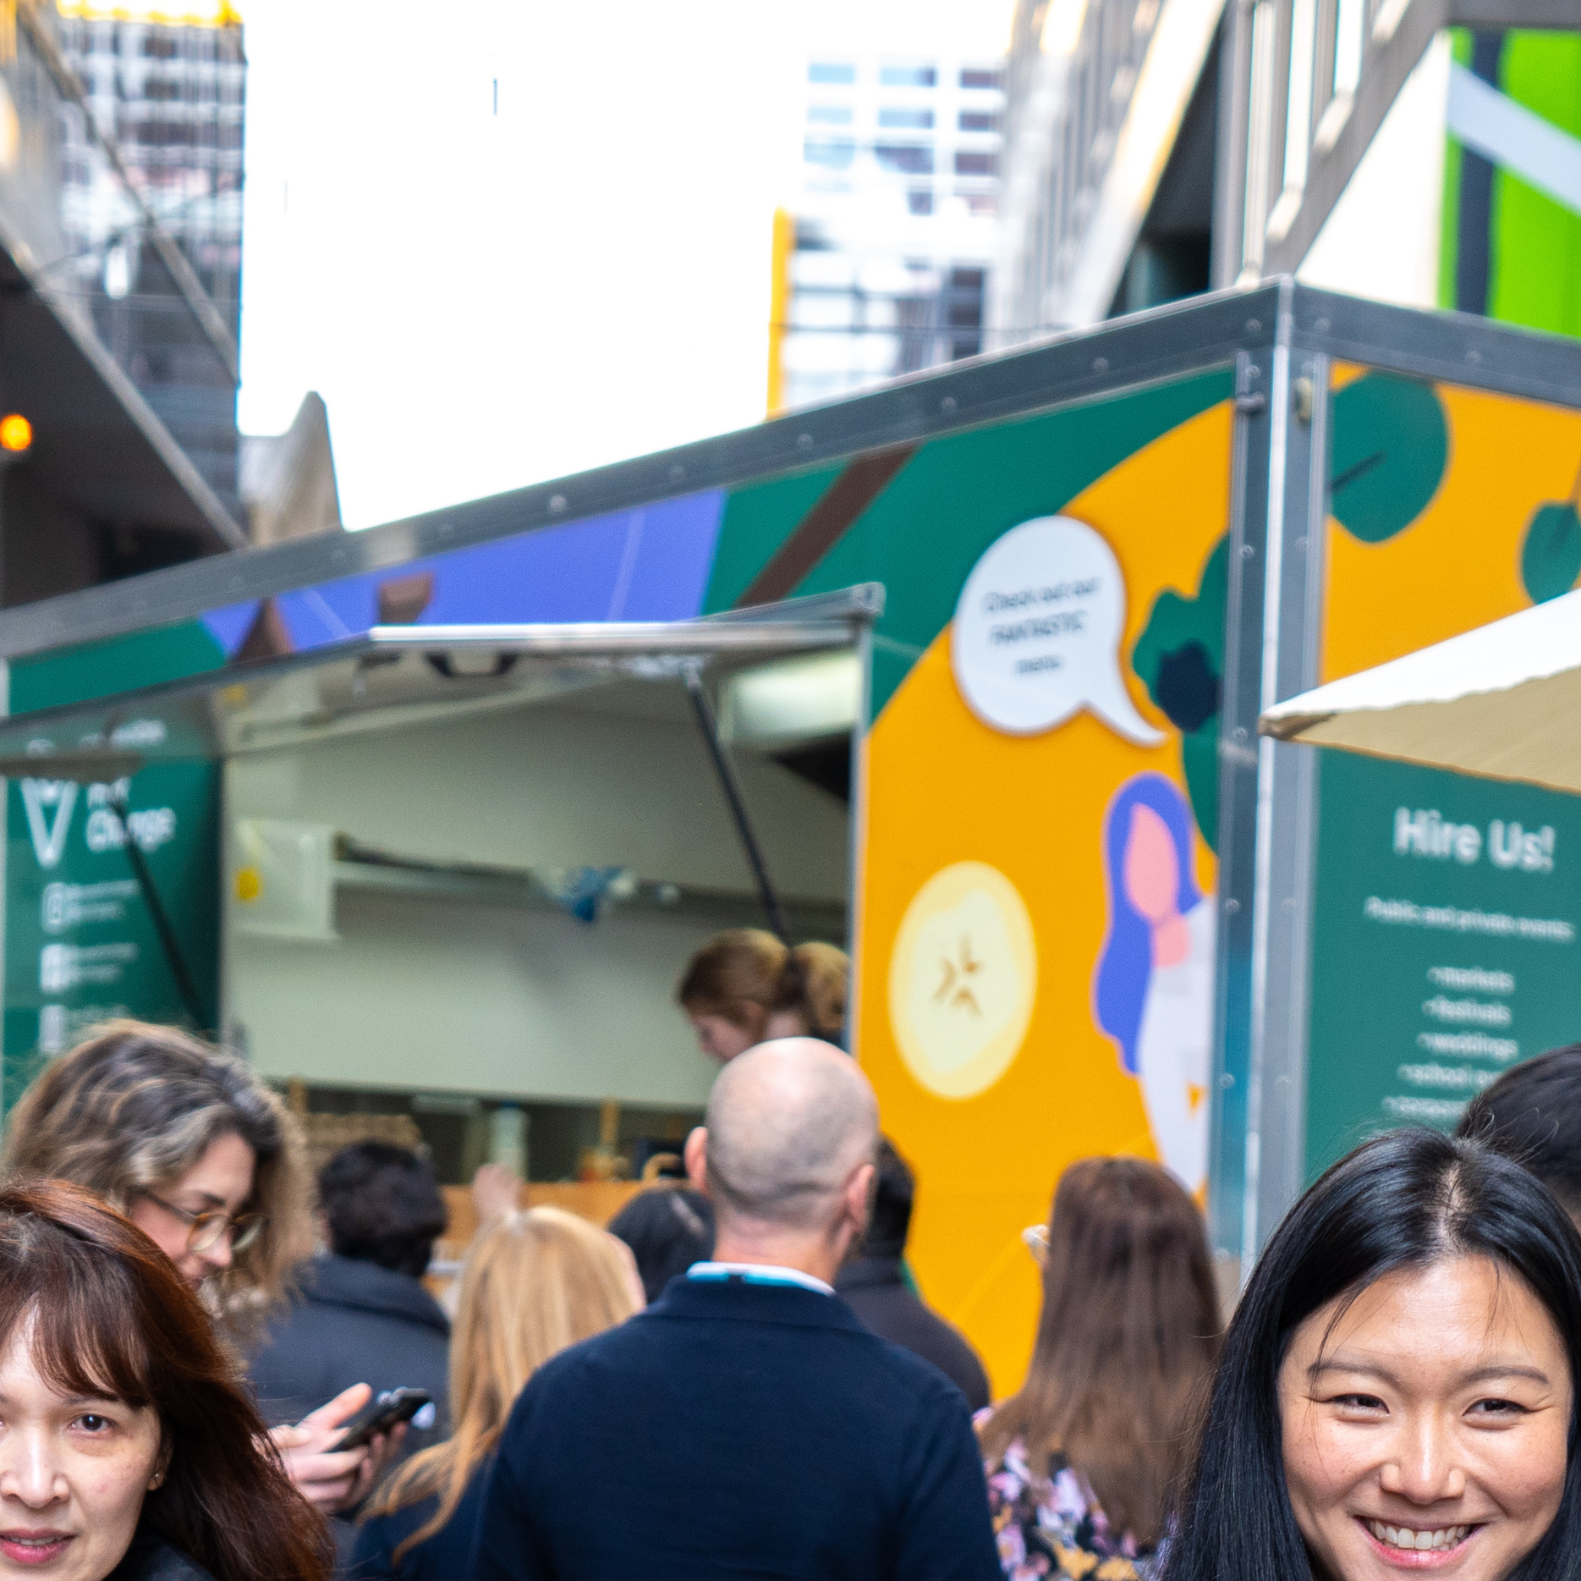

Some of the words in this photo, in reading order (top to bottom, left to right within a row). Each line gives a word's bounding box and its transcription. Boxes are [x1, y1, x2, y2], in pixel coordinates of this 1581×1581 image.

[1393, 806, 1482, 865] Hire
[1488, 819, 1556, 874] Us!
[1365, 896, 1418, 925] Public
